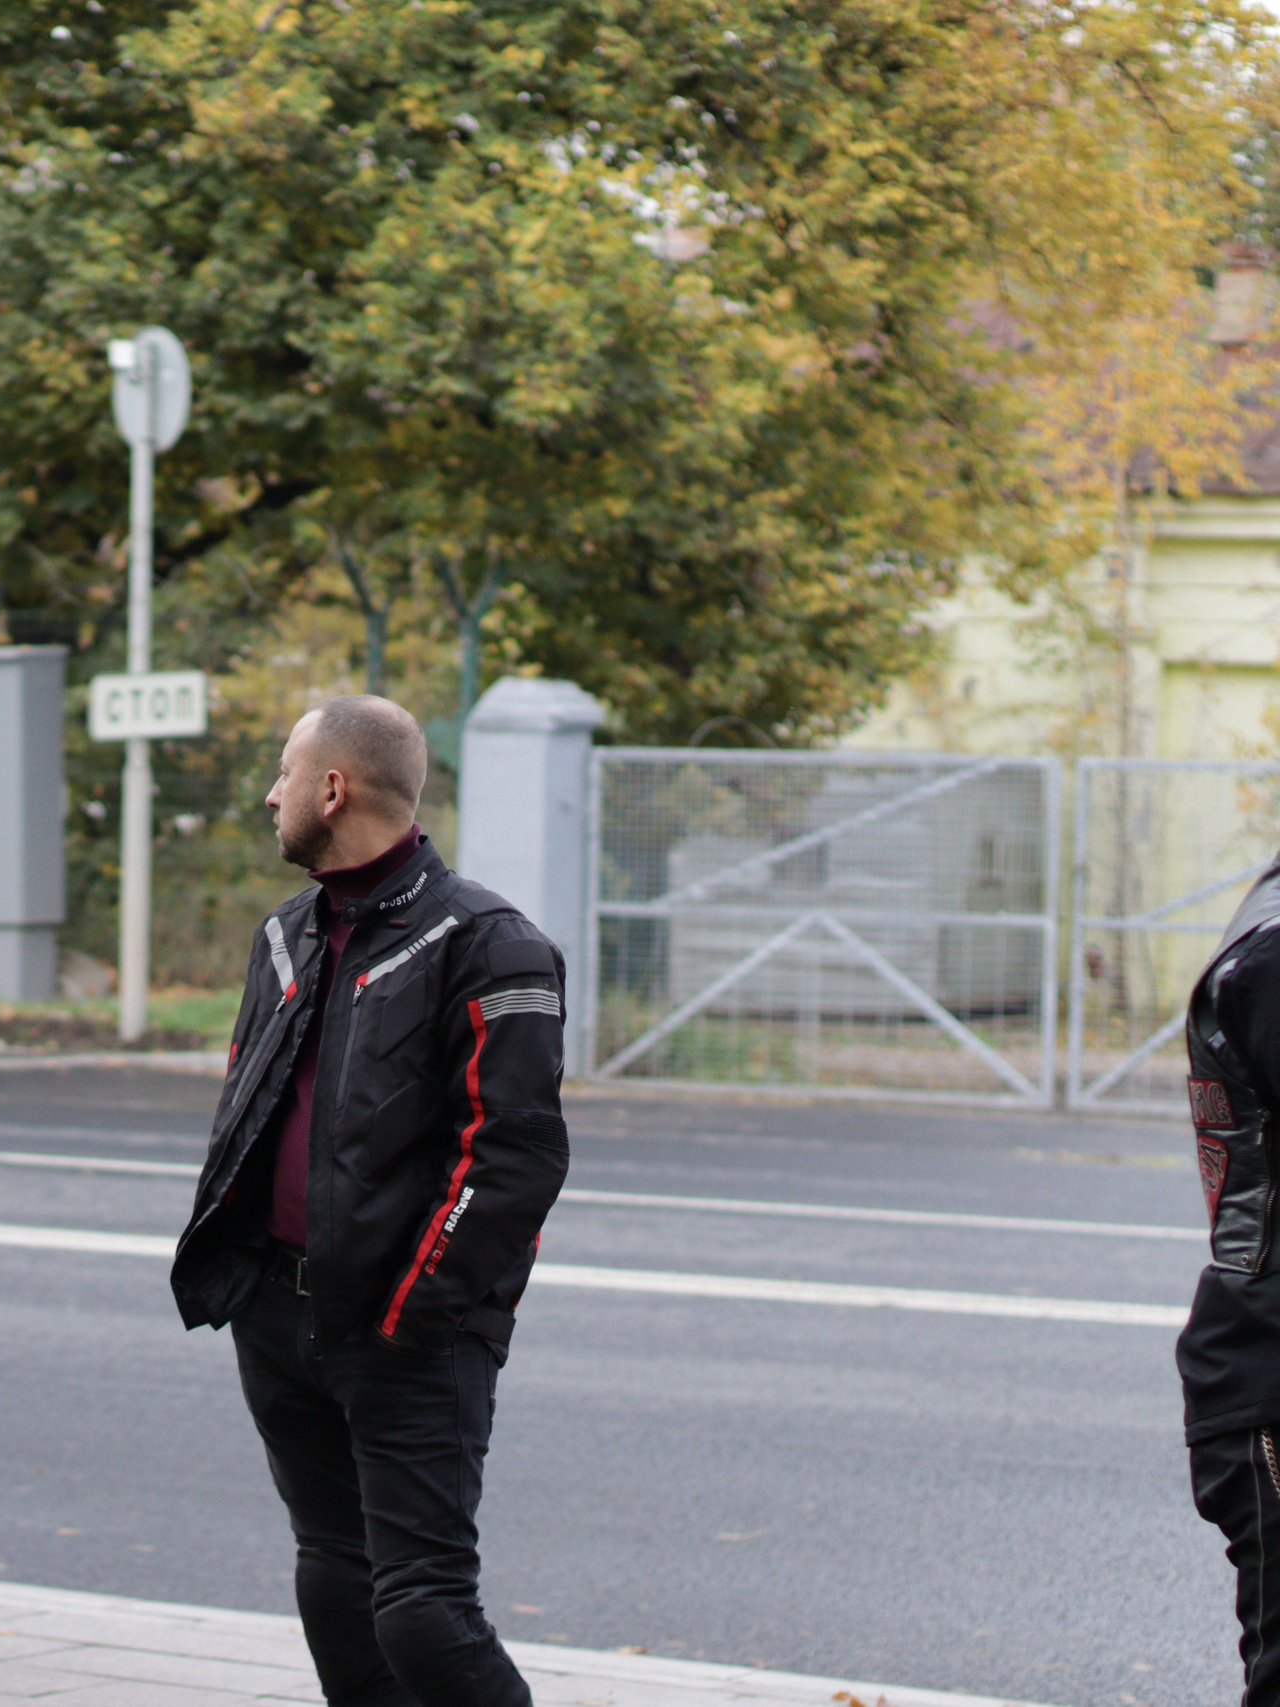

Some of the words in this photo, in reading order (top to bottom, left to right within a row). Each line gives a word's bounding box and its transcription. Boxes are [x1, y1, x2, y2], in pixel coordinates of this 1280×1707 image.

[106, 686, 195, 722] СТОП
[425, 1233, 450, 1275] GHOST
[444, 1186, 475, 1233] RACING
